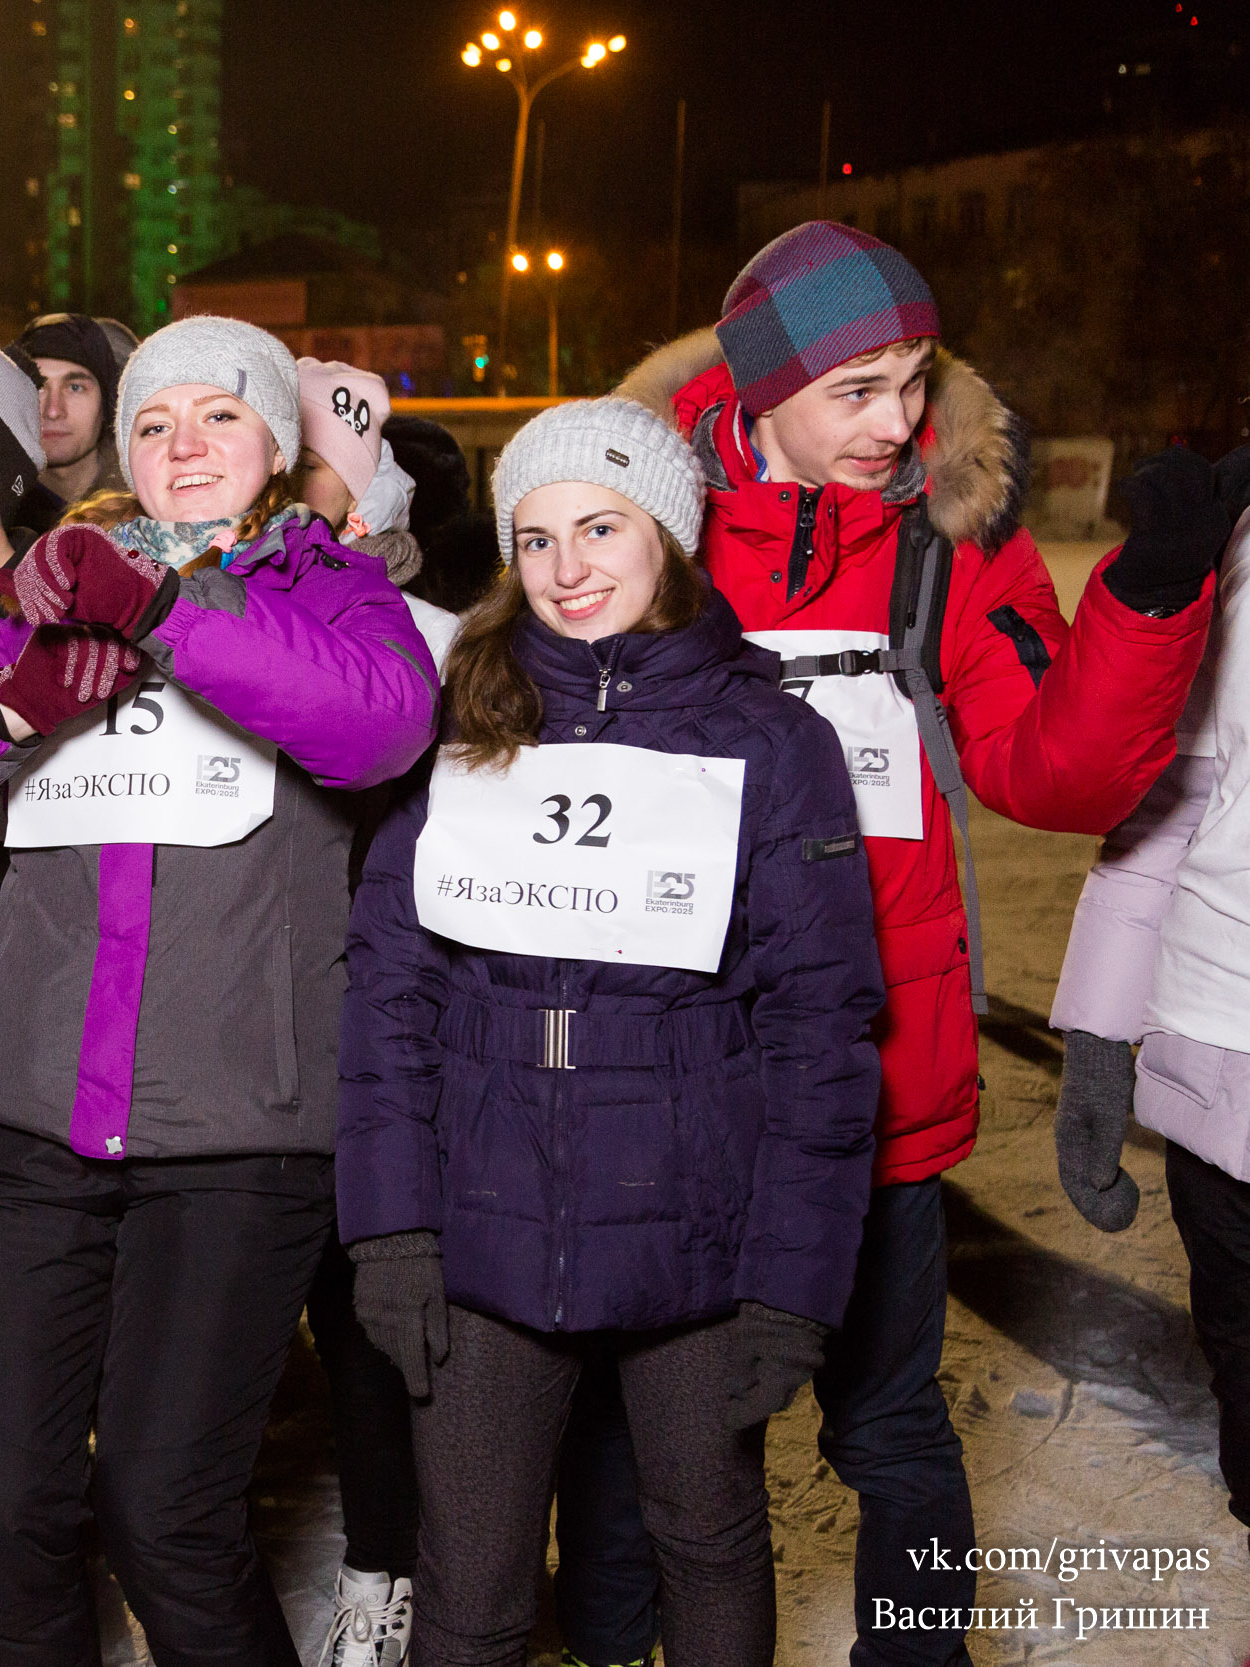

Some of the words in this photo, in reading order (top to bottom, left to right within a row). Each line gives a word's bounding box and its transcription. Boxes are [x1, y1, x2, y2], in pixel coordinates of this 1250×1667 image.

[99, 681, 166, 736] 15
[24, 772, 171, 801] #ЯзаЭКСПО
[195, 780, 240, 791] Ekaterinburg
[532, 793, 612, 848] 32
[437, 873, 619, 914] #ЯзаЭКСПО
[645, 898, 694, 909] Ekaterinburg
[645, 905, 694, 915] EXPO/2025
